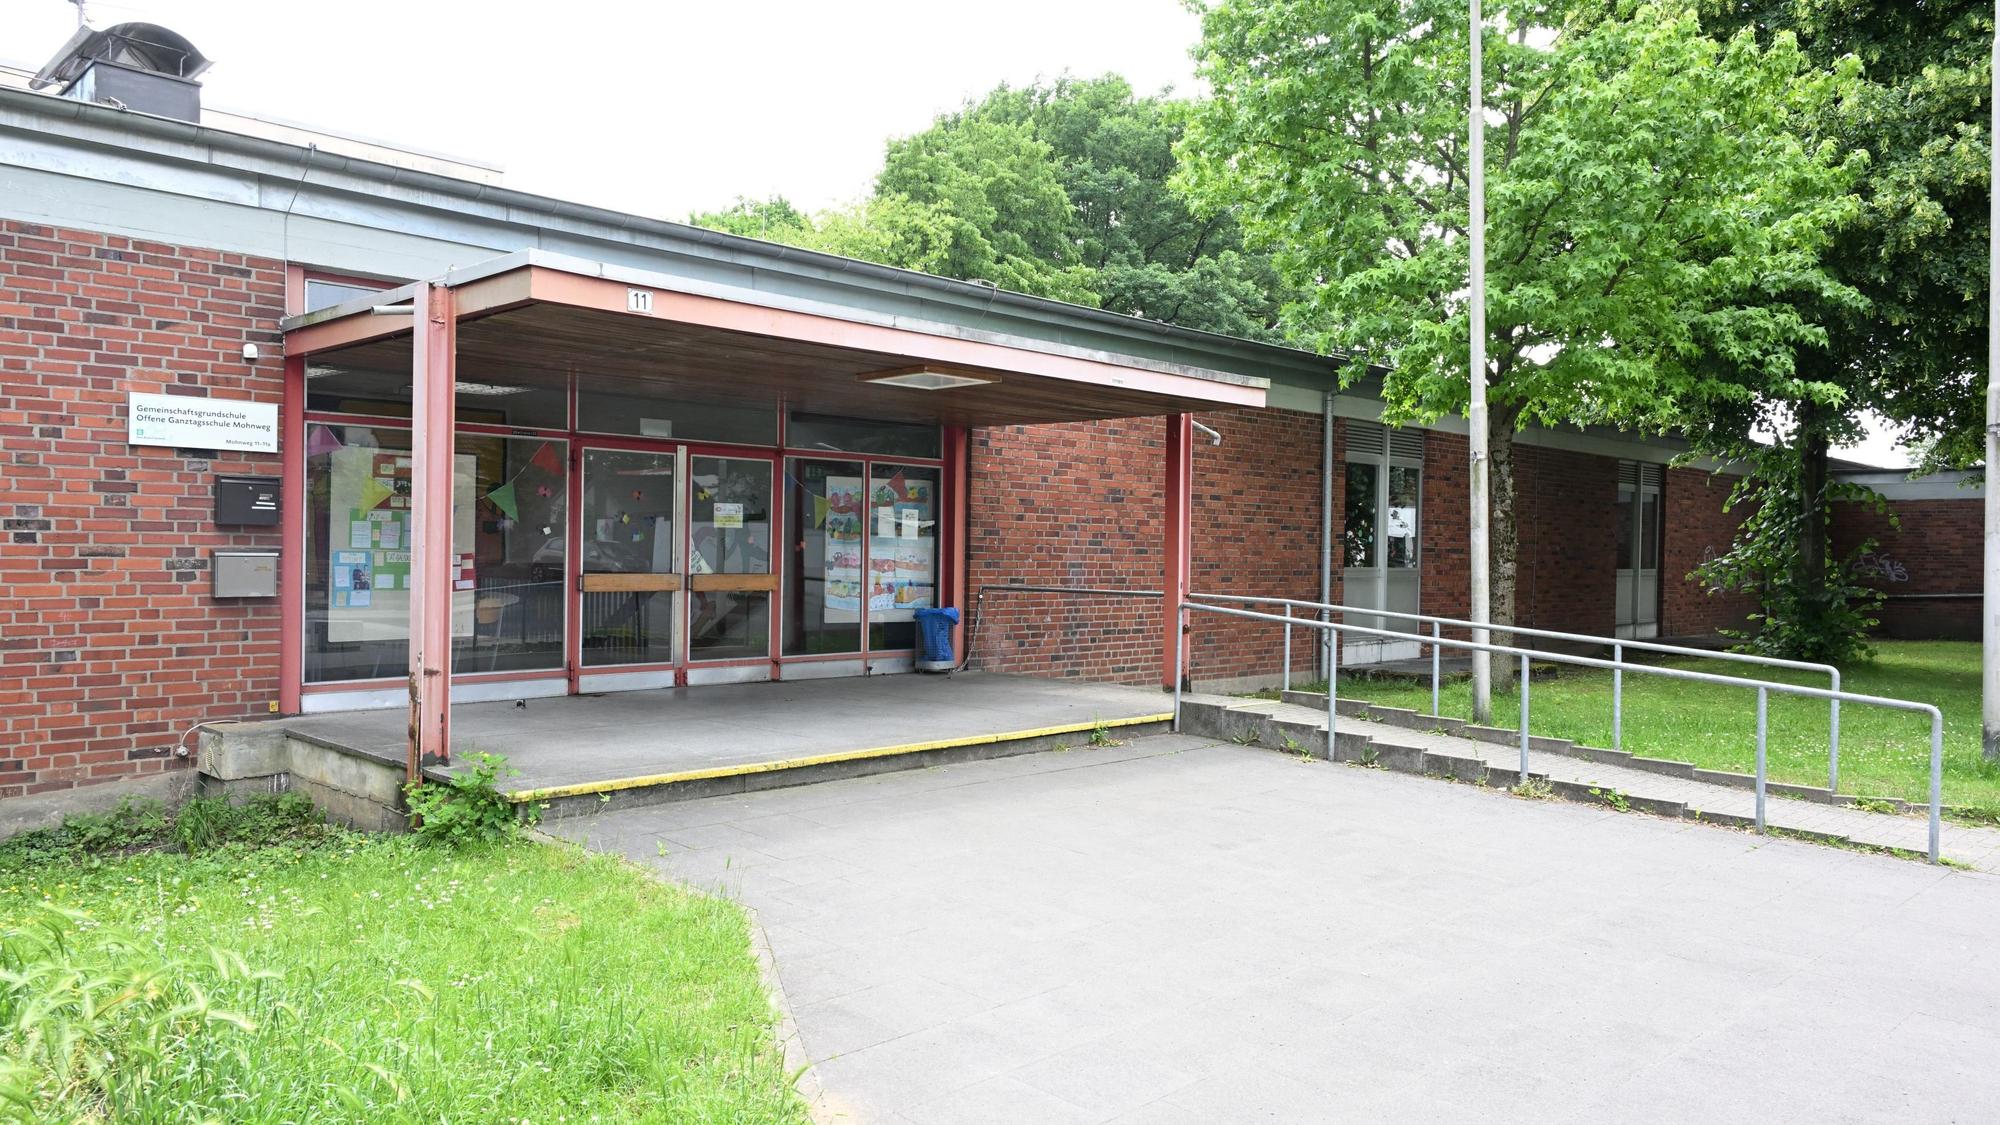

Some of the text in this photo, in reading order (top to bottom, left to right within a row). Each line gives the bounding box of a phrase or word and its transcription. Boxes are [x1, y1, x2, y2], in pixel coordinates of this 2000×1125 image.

[633, 292, 647, 310] 11
[136, 404, 247, 420] Gemeinschaftsgrundschule
[136, 414, 271, 432] Offene Ganztagsschule Mohnweg
[225, 439, 253, 447] Mohnweg
